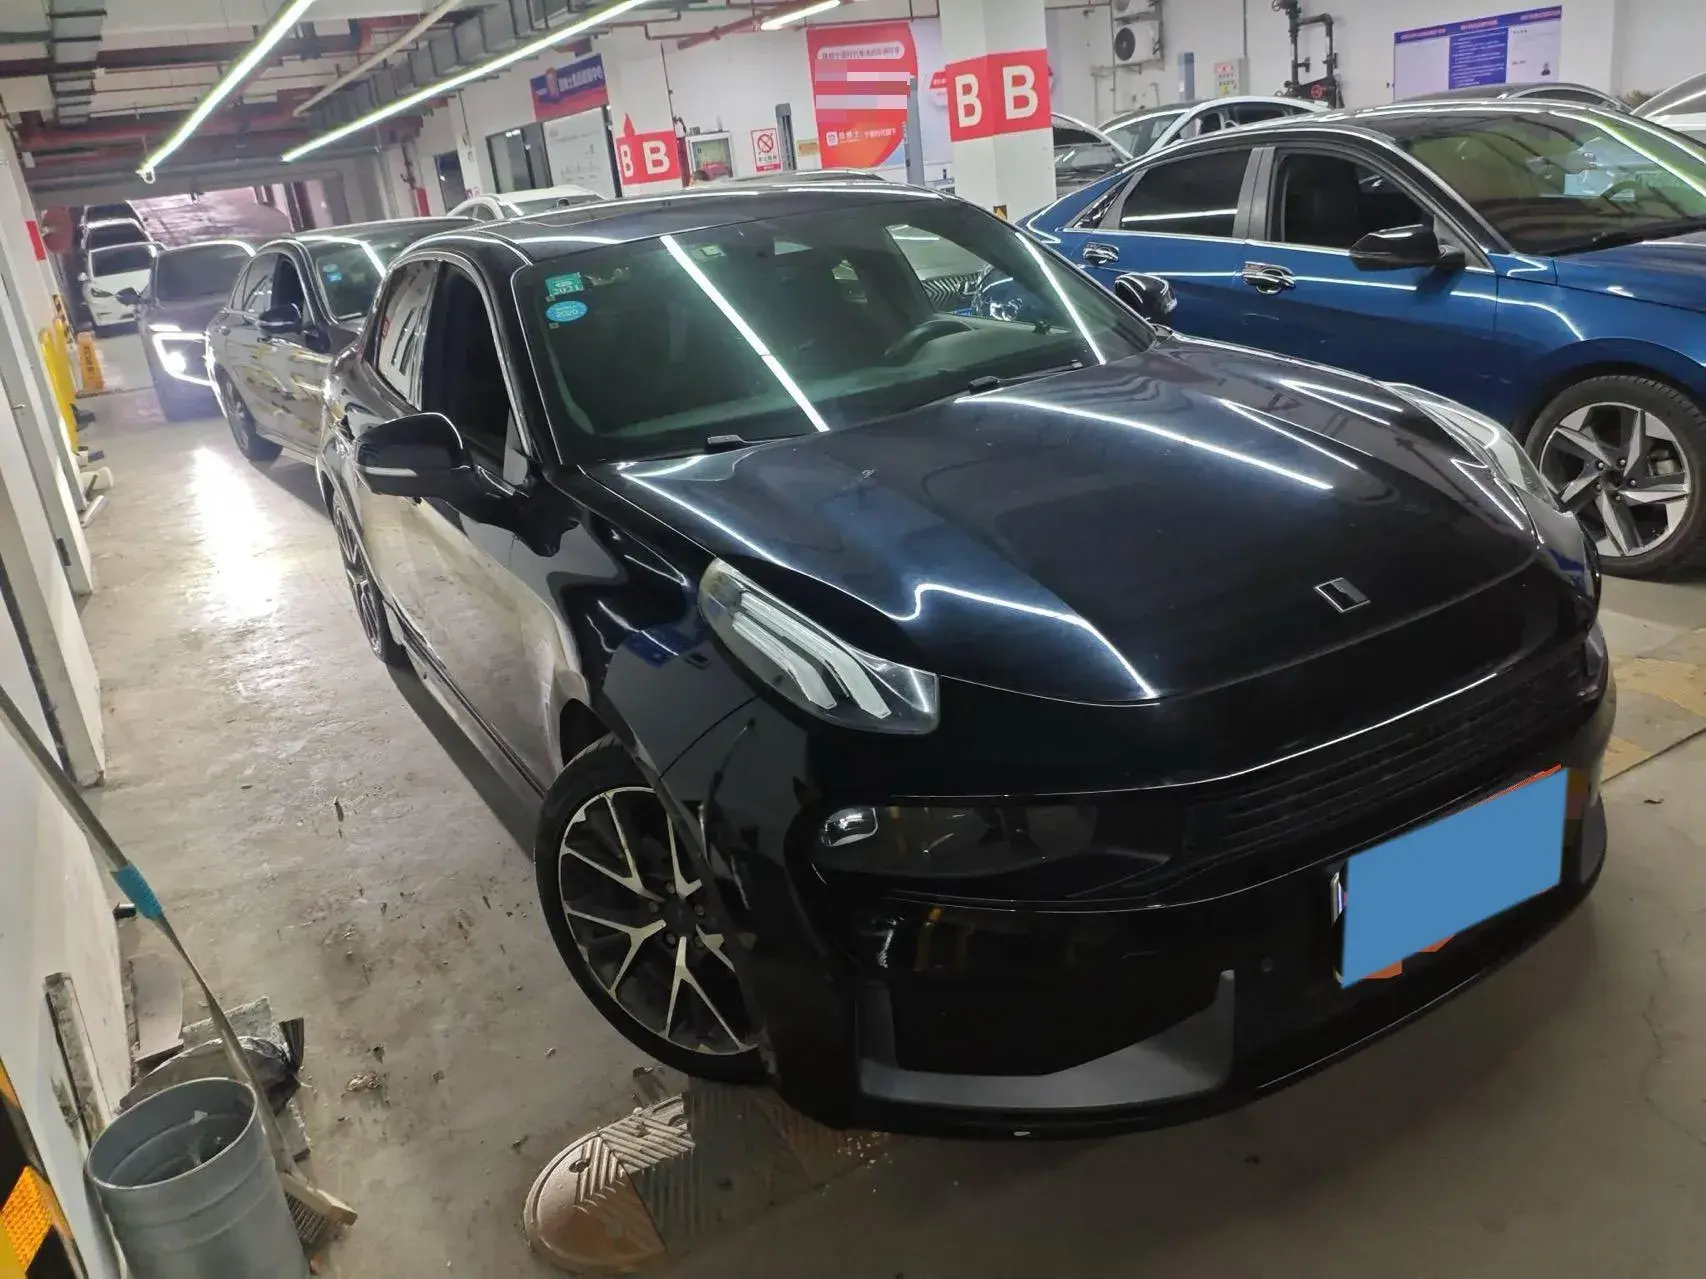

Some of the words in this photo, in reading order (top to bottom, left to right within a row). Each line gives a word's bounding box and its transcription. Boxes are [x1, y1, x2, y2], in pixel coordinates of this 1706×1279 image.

[954, 73, 982, 128] B
[1002, 65, 1038, 120] B
[620, 144, 634, 177] B
[642, 140, 670, 175] B
